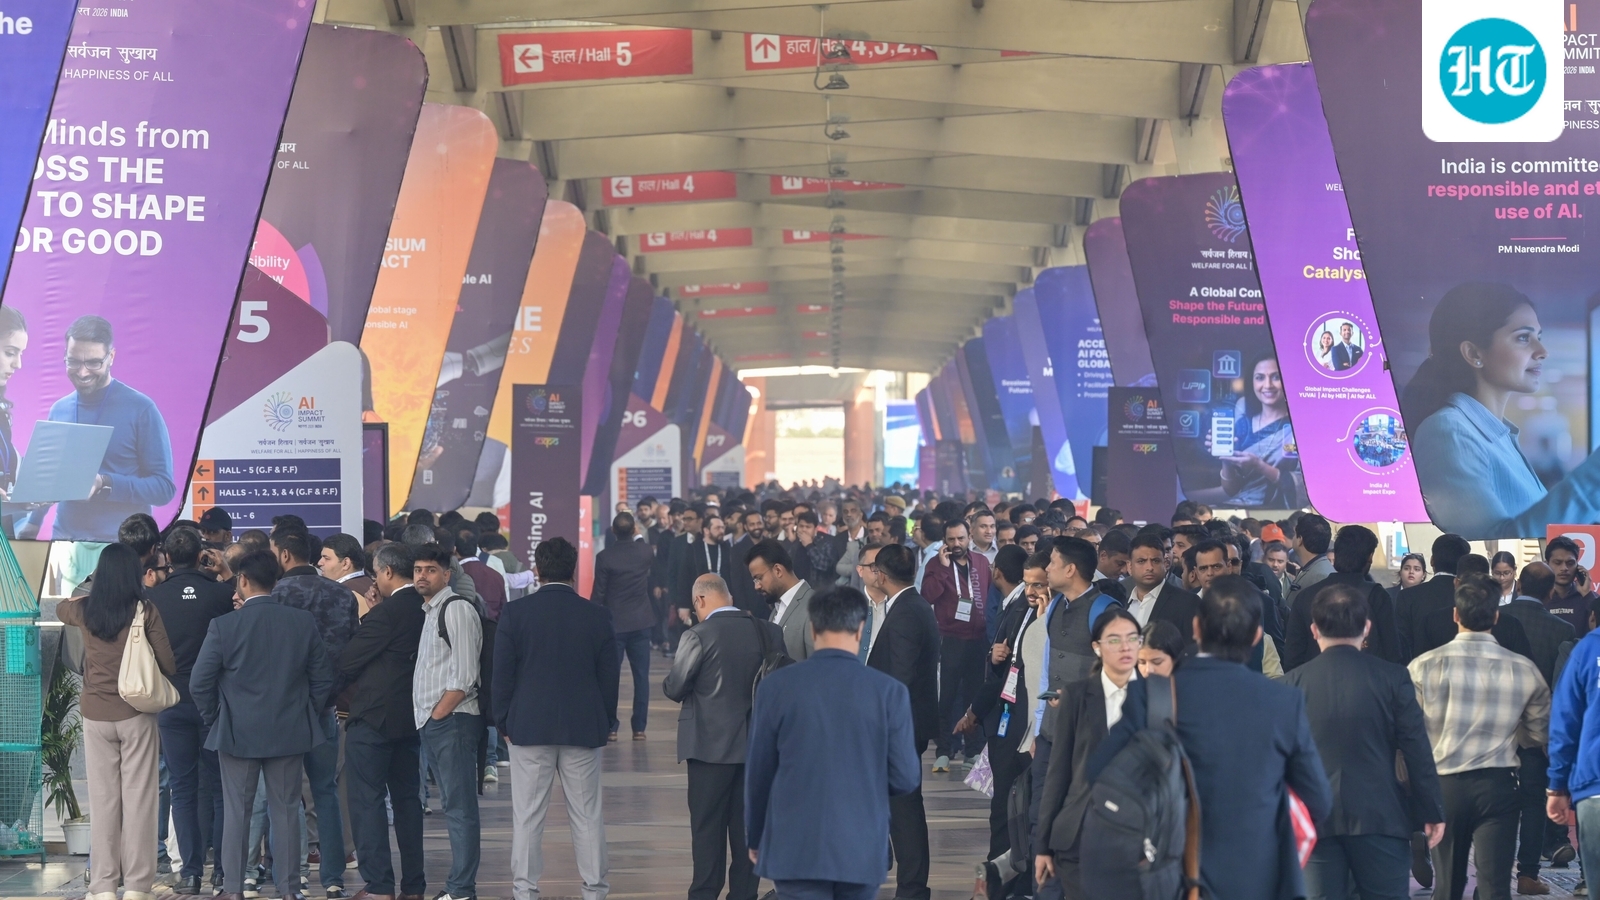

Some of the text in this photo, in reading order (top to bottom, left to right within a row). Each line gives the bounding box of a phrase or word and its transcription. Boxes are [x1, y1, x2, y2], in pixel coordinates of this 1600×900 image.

[92, 8, 108, 17] 2026
[110, 8, 128, 18] INDIA
[67, 41, 158, 64] सर्वजन सुखाय
[785, 39, 812, 54] हाल
[551, 49, 577, 64] हाल
[586, 48, 611, 62] Hall
[616, 42, 632, 67] 5
[64, 68, 174, 82] HAPPINESS OF ALL
[1578, 66, 1596, 74] INDIA
[135, 121, 209, 150] from
[97, 156, 164, 184] THE
[277, 161, 310, 170] OF ALL
[1441, 157, 1600, 174] India is committe
[638, 175, 695, 193] हाल Hall 4
[1325, 183, 1343, 192] WEL
[1427, 180, 1540, 201] responsible
[1543, 180, 1579, 196] and
[37, 190, 205, 222] TO SHAPE
[1494, 203, 1583, 219] use of AI.
[689, 230, 704, 240] Hall
[707, 229, 717, 242] 4
[62, 227, 163, 257] GOOD
[1201, 248, 1226, 259] सर्वजन
[1498, 244, 1580, 254] PM Narendra Modi
[1191, 262, 1221, 270] WELFARE
[1235, 262, 1248, 270] ALL
[479, 274, 492, 284] AI
[1189, 286, 1262, 298] A Global Con
[393, 307, 417, 316] stage
[1169, 300, 1264, 313] Shape the Future
[236, 300, 271, 343] 5
[399, 321, 408, 329] AI
[1172, 313, 1265, 326] Responsible and
[1077, 349, 1088, 359] AI
[298, 396, 315, 410] AI
[549, 393, 560, 402] AI
[1147, 400, 1158, 408] AI
[297, 415, 326, 423] SUMMIT
[621, 410, 648, 428] P6
[706, 435, 726, 447] P7
[255, 466, 273, 475] (G.F
[282, 466, 298, 474] F.F)
[254, 489, 260, 497] 1,
[262, 489, 270, 497] 2,
[271, 489, 279, 497] 3,
[281, 488, 288, 496] &
[288, 488, 295, 496] 4
[295, 488, 313, 497] (G.F
[314, 488, 321, 496] &
[322, 487, 339, 496] F.F)
[529, 492, 544, 509] AI
[249, 512, 255, 520] 6
